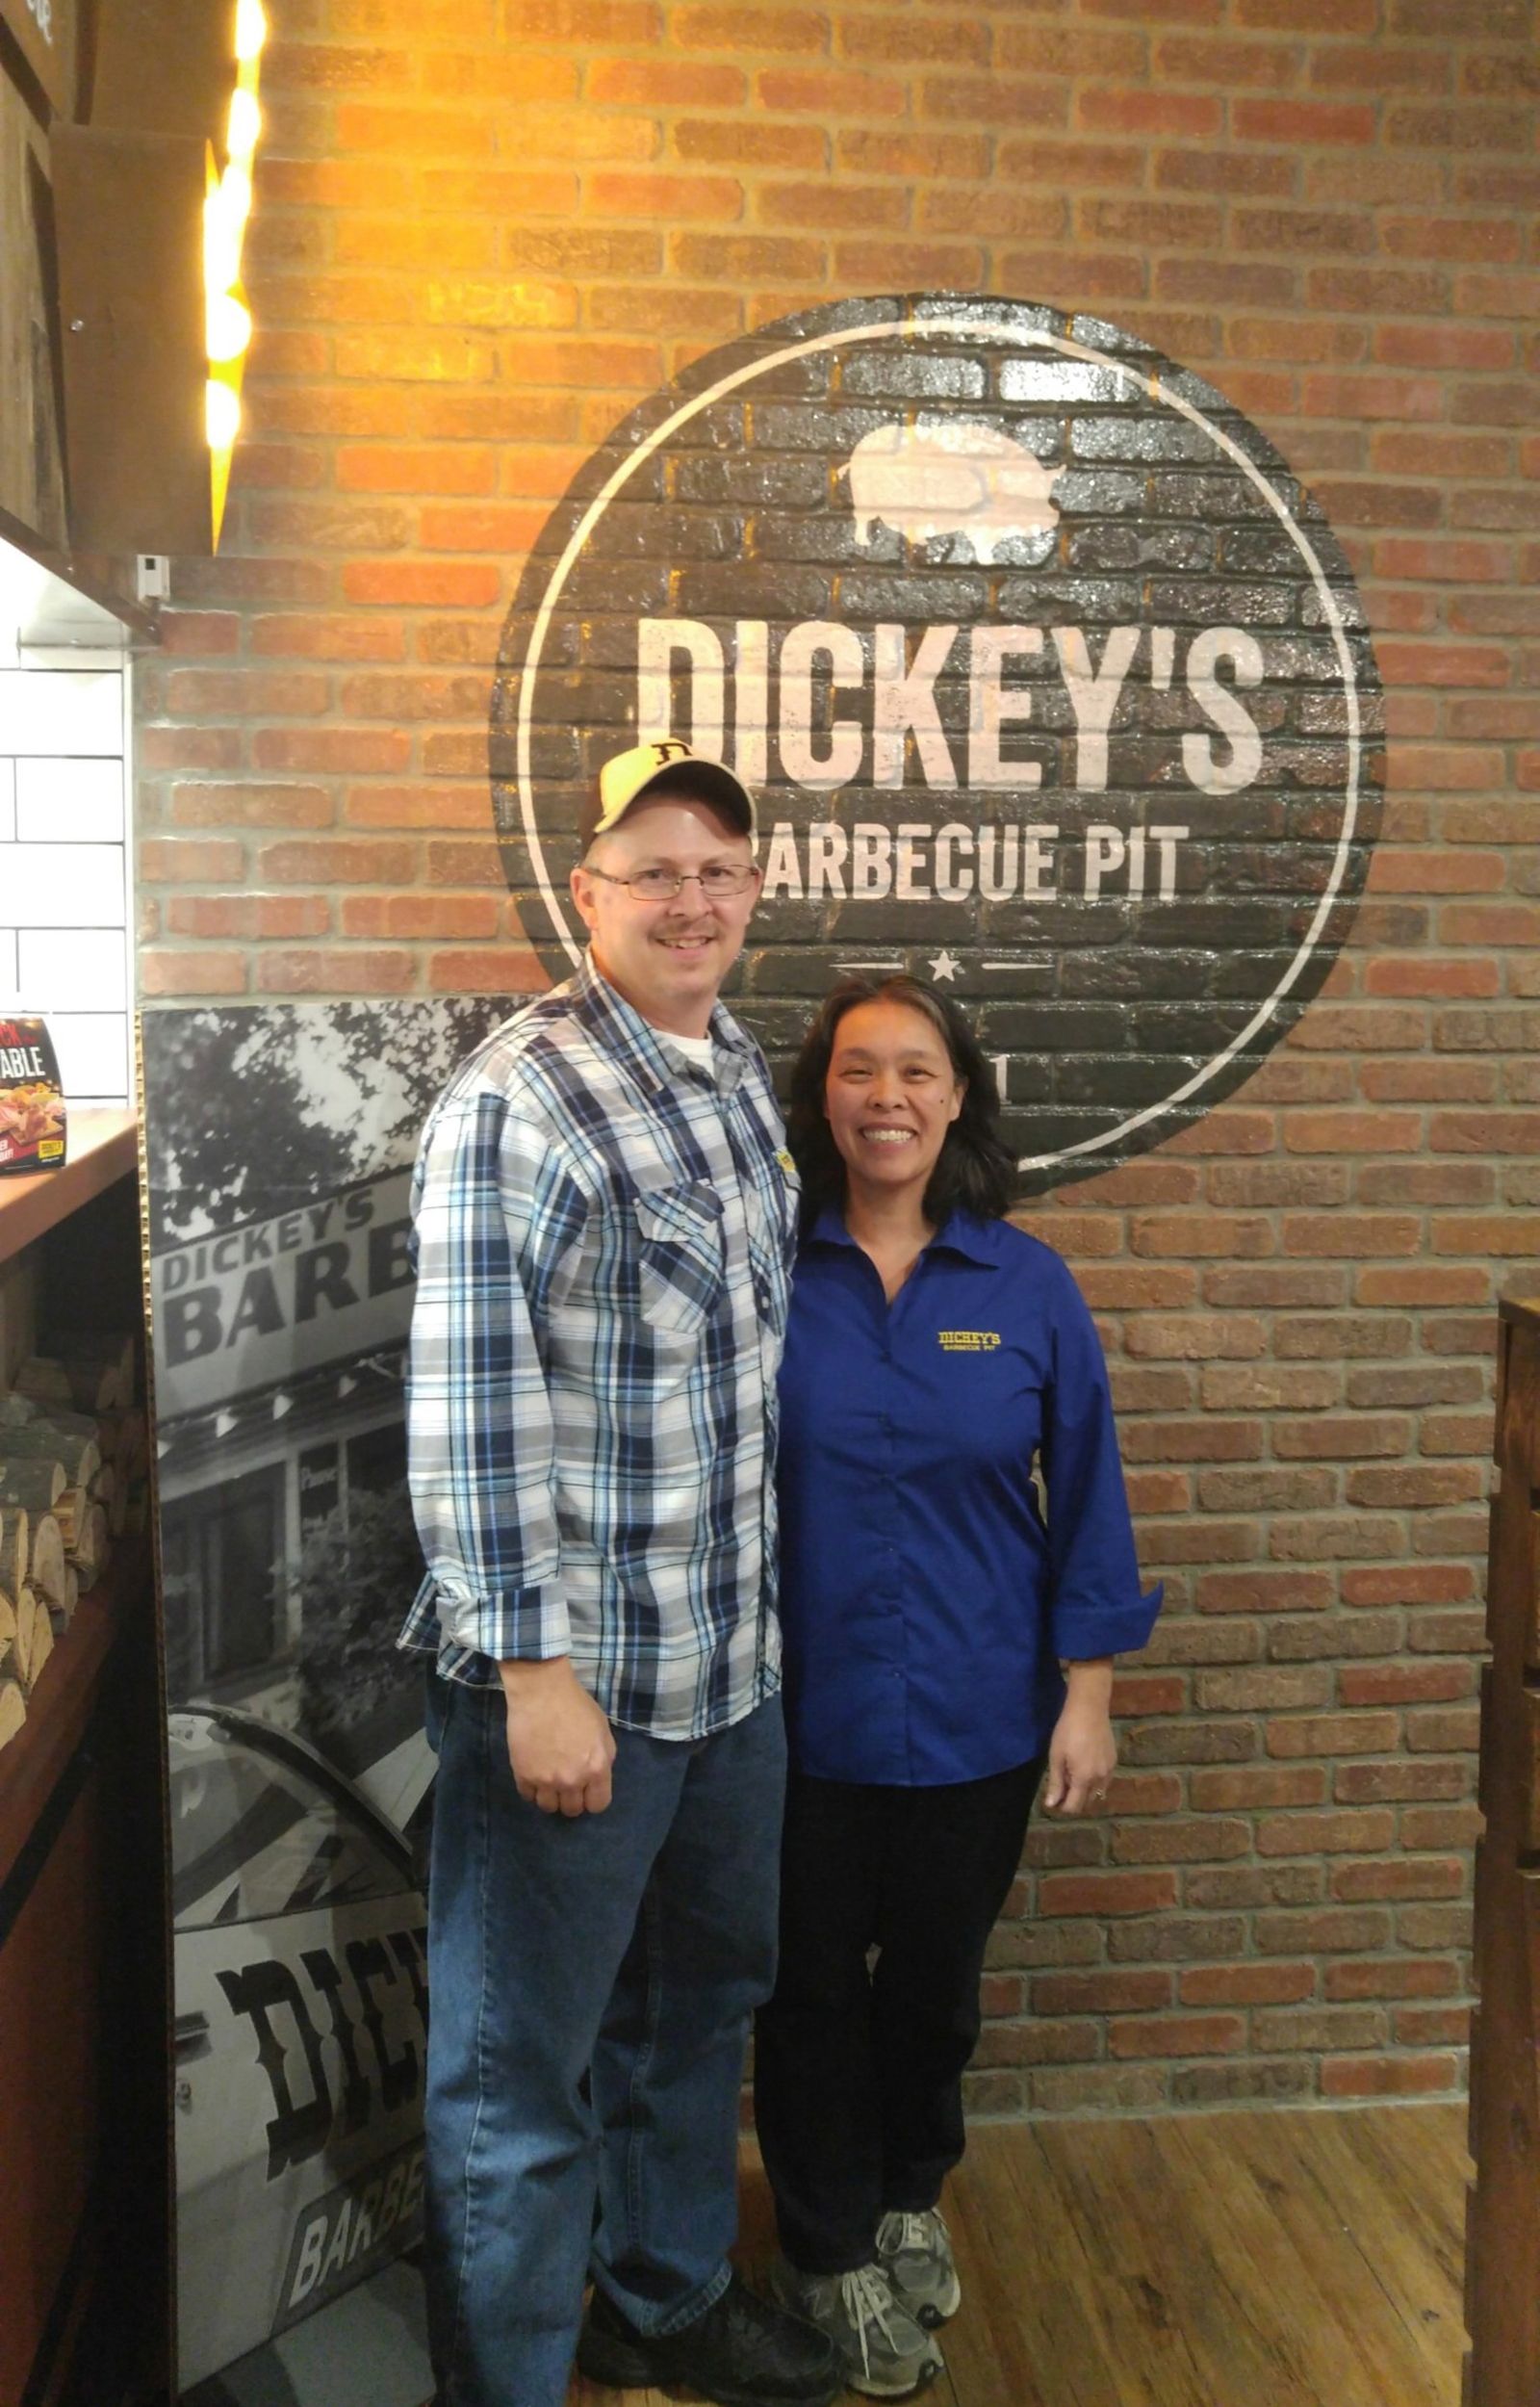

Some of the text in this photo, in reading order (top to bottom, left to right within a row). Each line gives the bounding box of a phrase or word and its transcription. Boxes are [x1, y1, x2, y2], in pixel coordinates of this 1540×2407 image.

[638, 618, 1264, 795] DICKEY'S
[752, 822, 1190, 901] ARBECUE PIT
[162, 1188, 374, 1293] DICKEY'S
